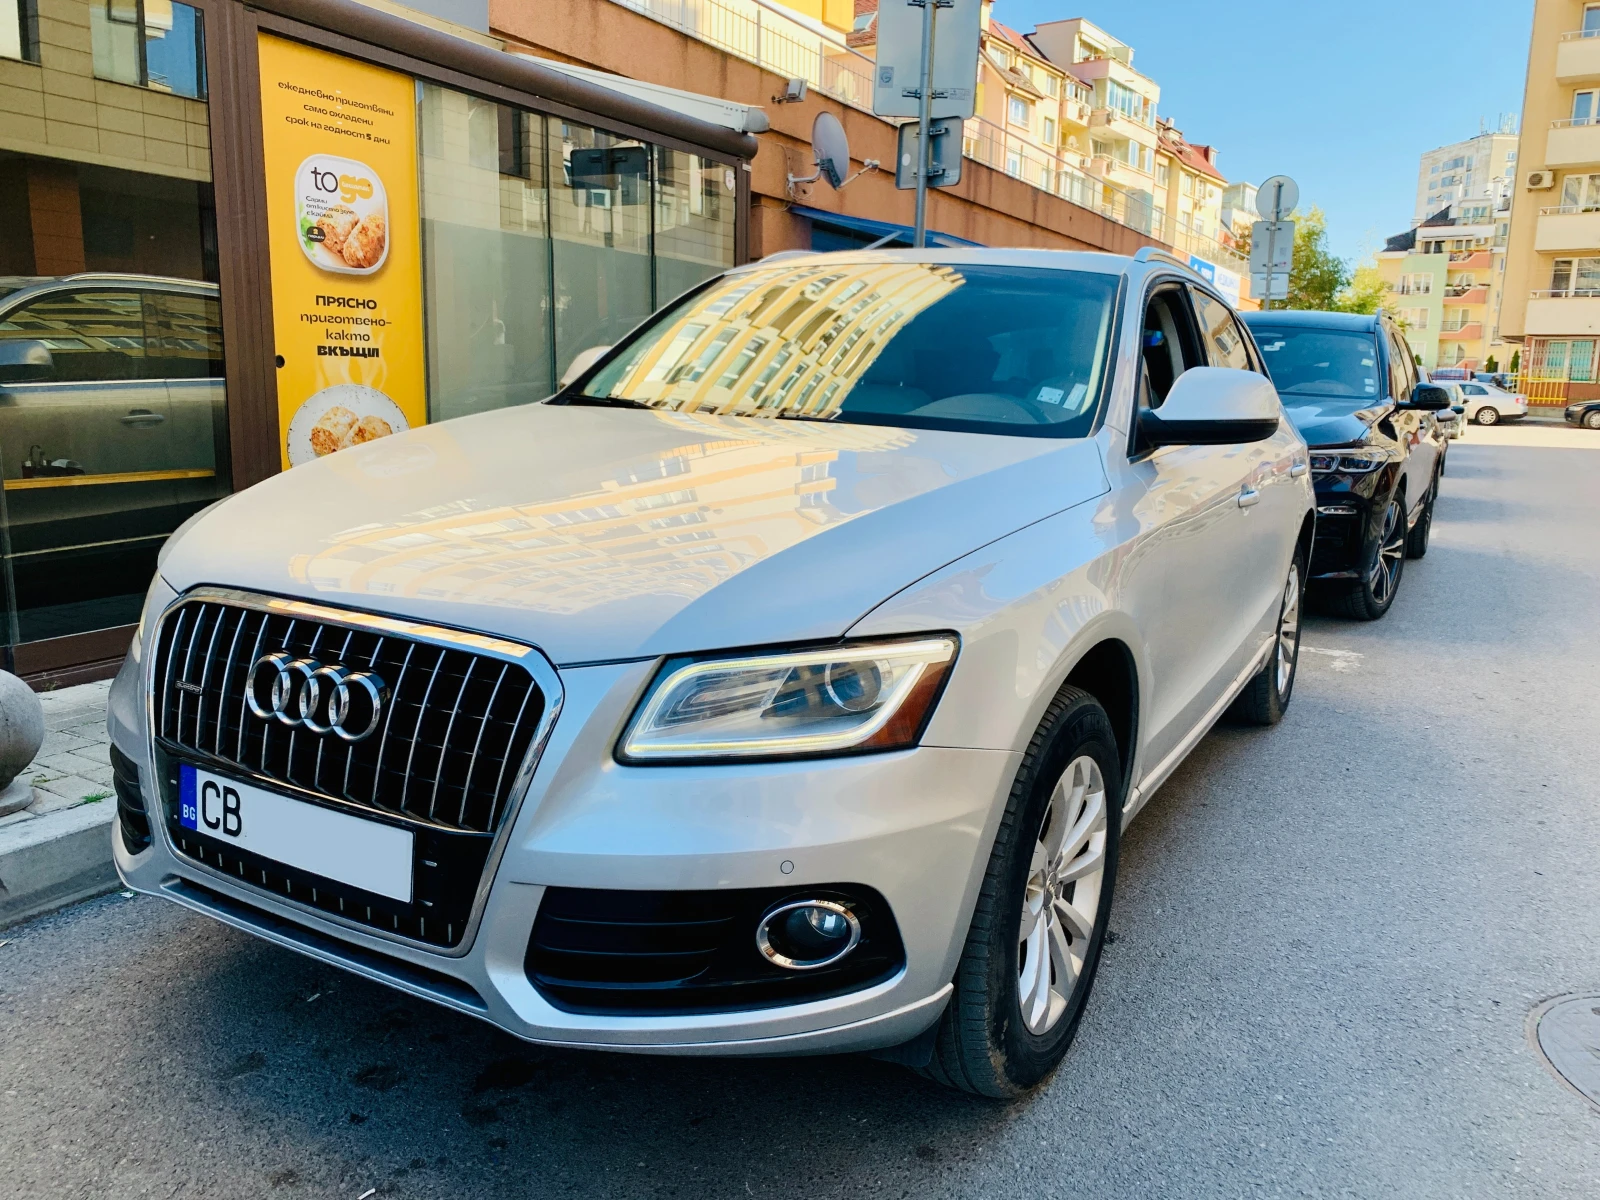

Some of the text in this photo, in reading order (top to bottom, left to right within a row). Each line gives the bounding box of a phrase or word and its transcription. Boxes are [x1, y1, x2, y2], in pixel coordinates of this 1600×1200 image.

[278, 81, 395, 117] ежедневно приготвяни
[303, 104, 374, 126] само охладени
[285, 115, 391, 145] срок на годност 5 дни
[315, 295, 377, 310] ПРЯСНО
[325, 328, 370, 342] както
[182, 803, 196, 821] BG
[201, 780, 242, 837] CB
